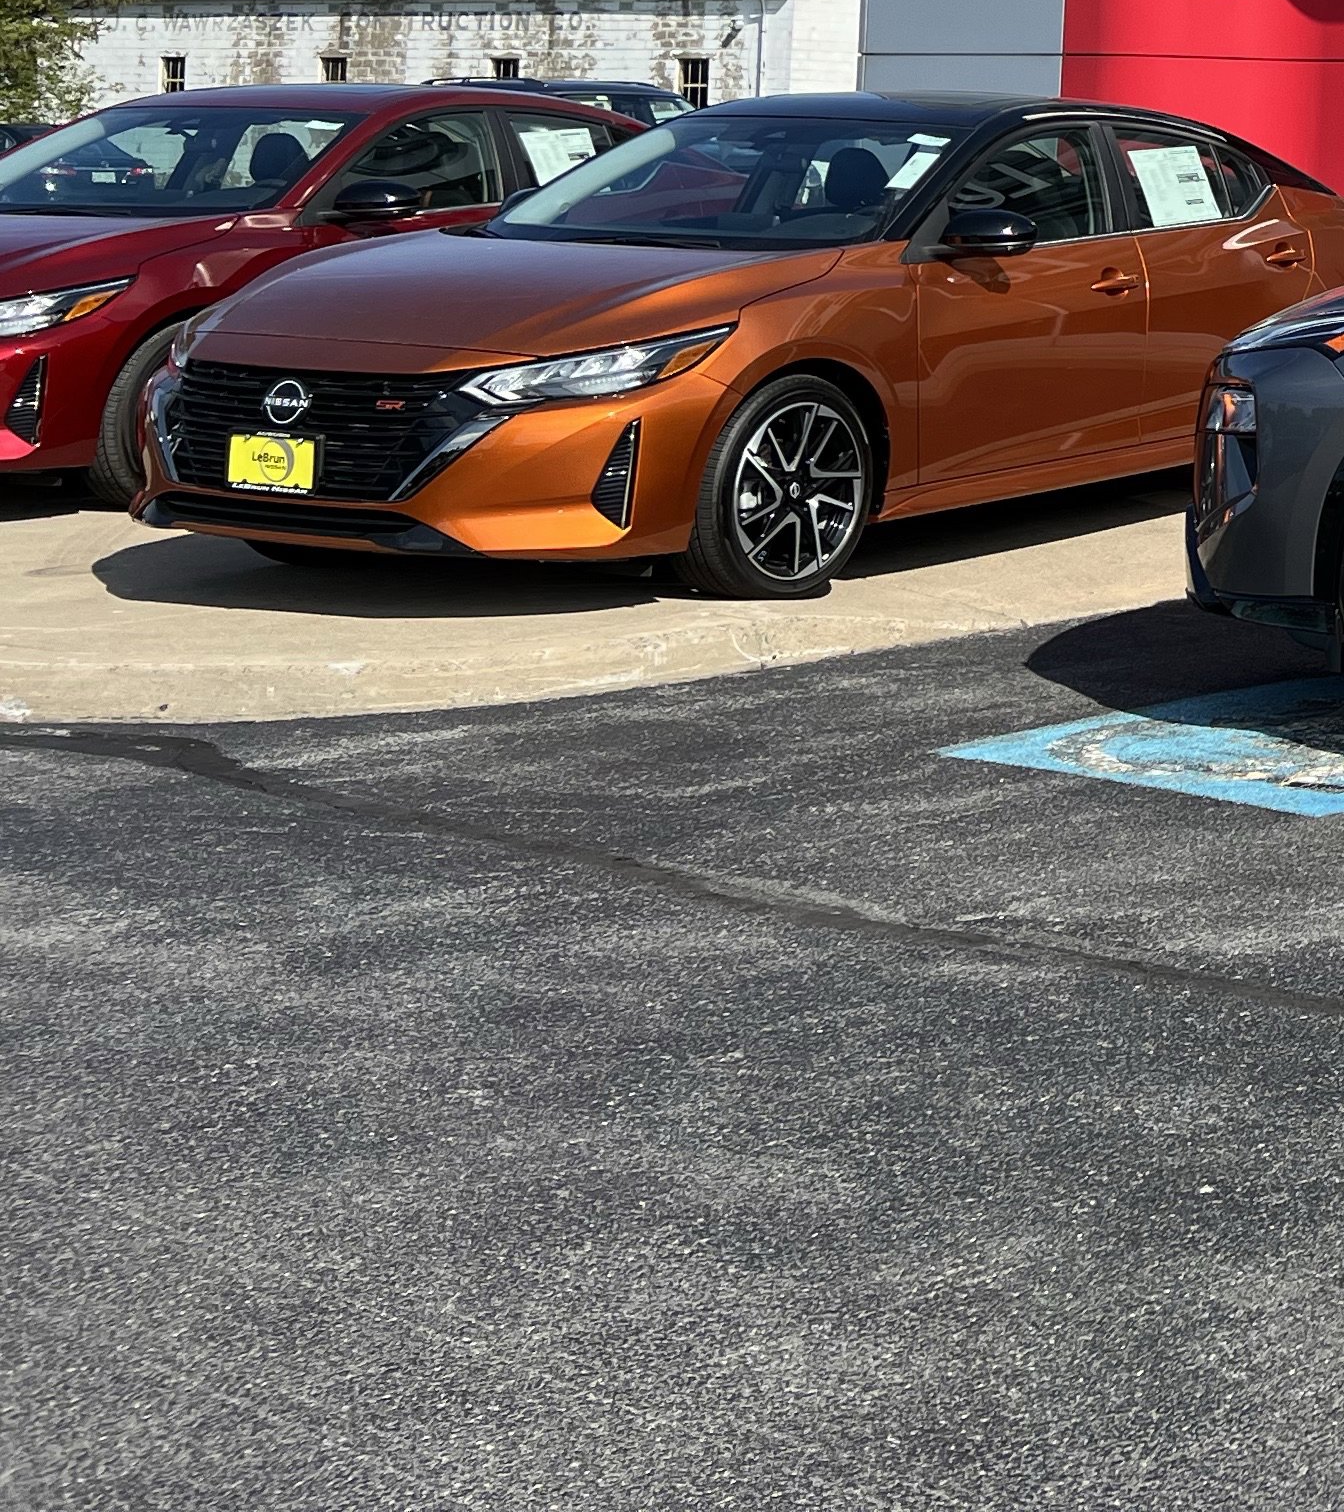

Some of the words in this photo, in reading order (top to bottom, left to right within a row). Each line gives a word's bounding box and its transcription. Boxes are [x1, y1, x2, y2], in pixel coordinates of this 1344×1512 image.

[263, 396, 309, 408] NISSAN
[375, 400, 406, 411] SR
[252, 451, 285, 464] LeBrun
